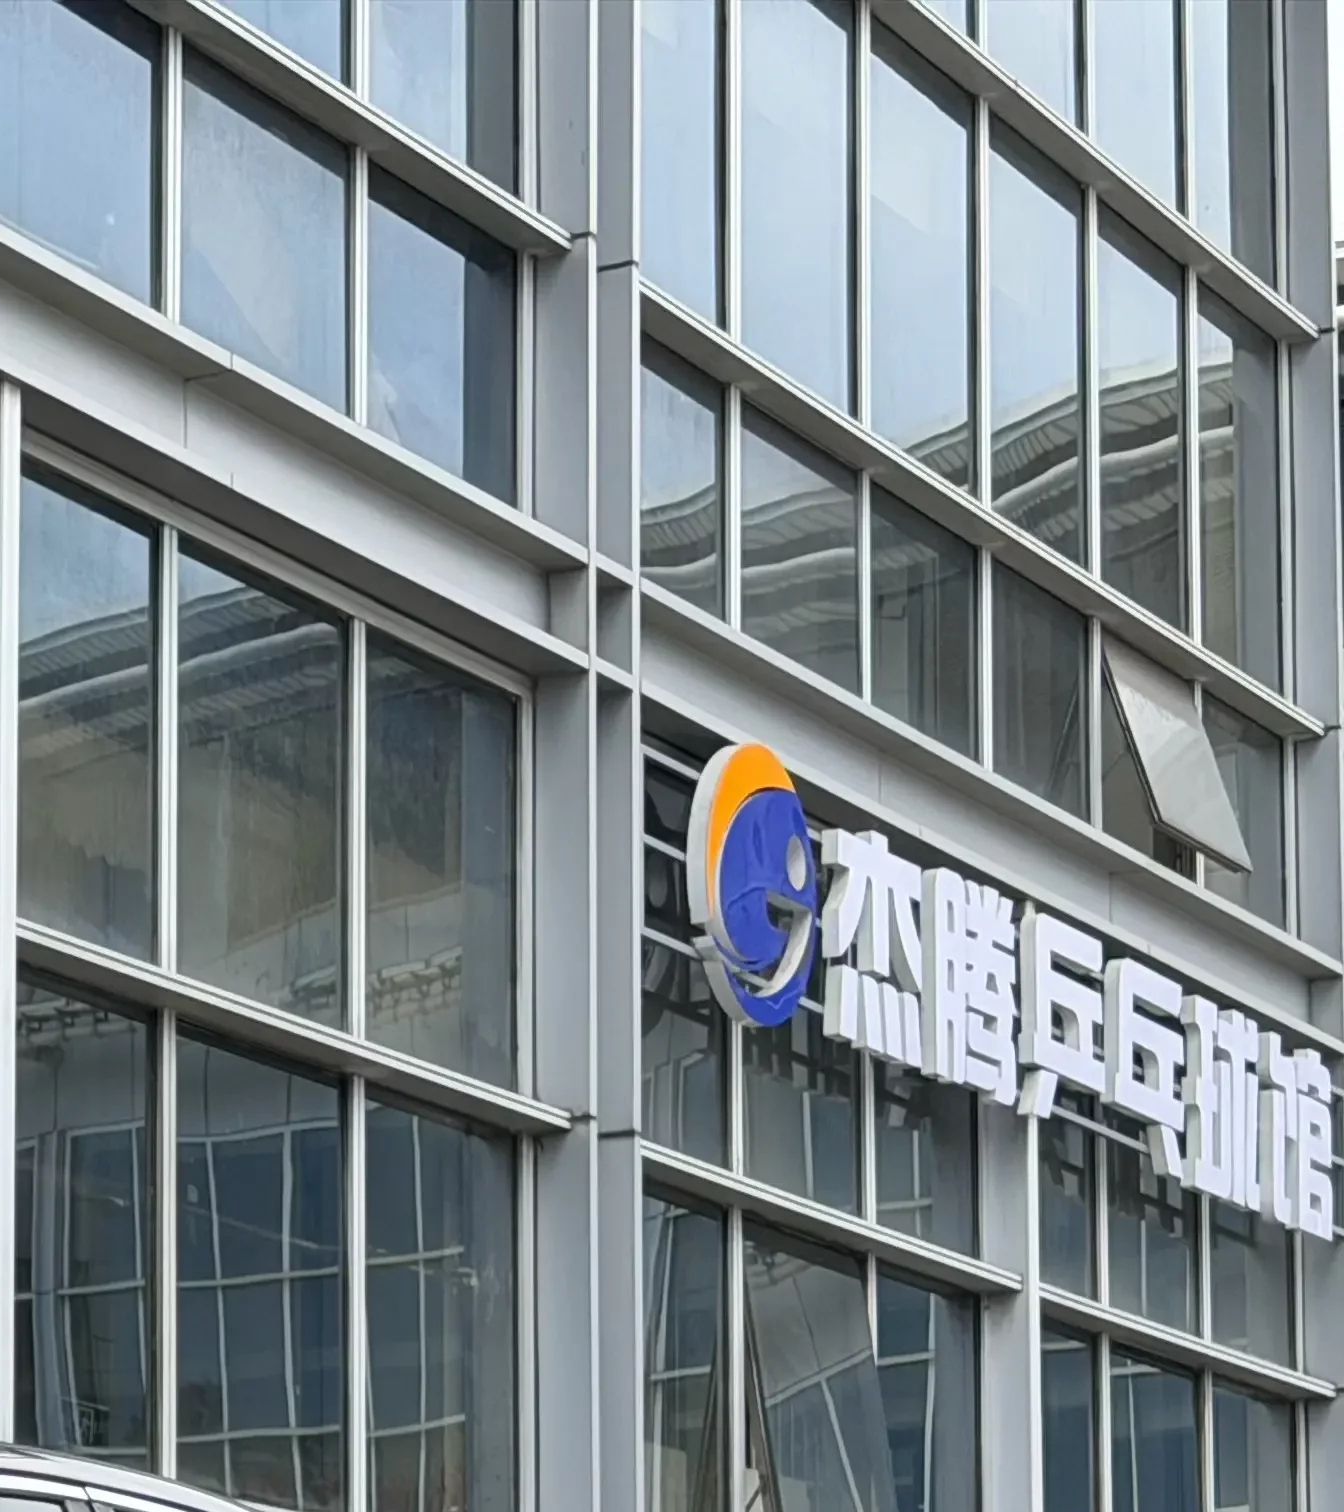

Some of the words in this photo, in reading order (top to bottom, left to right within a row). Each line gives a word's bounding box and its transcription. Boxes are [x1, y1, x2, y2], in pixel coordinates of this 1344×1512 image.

[821, 828, 1332, 1241] 杰腾乒乓球馆
